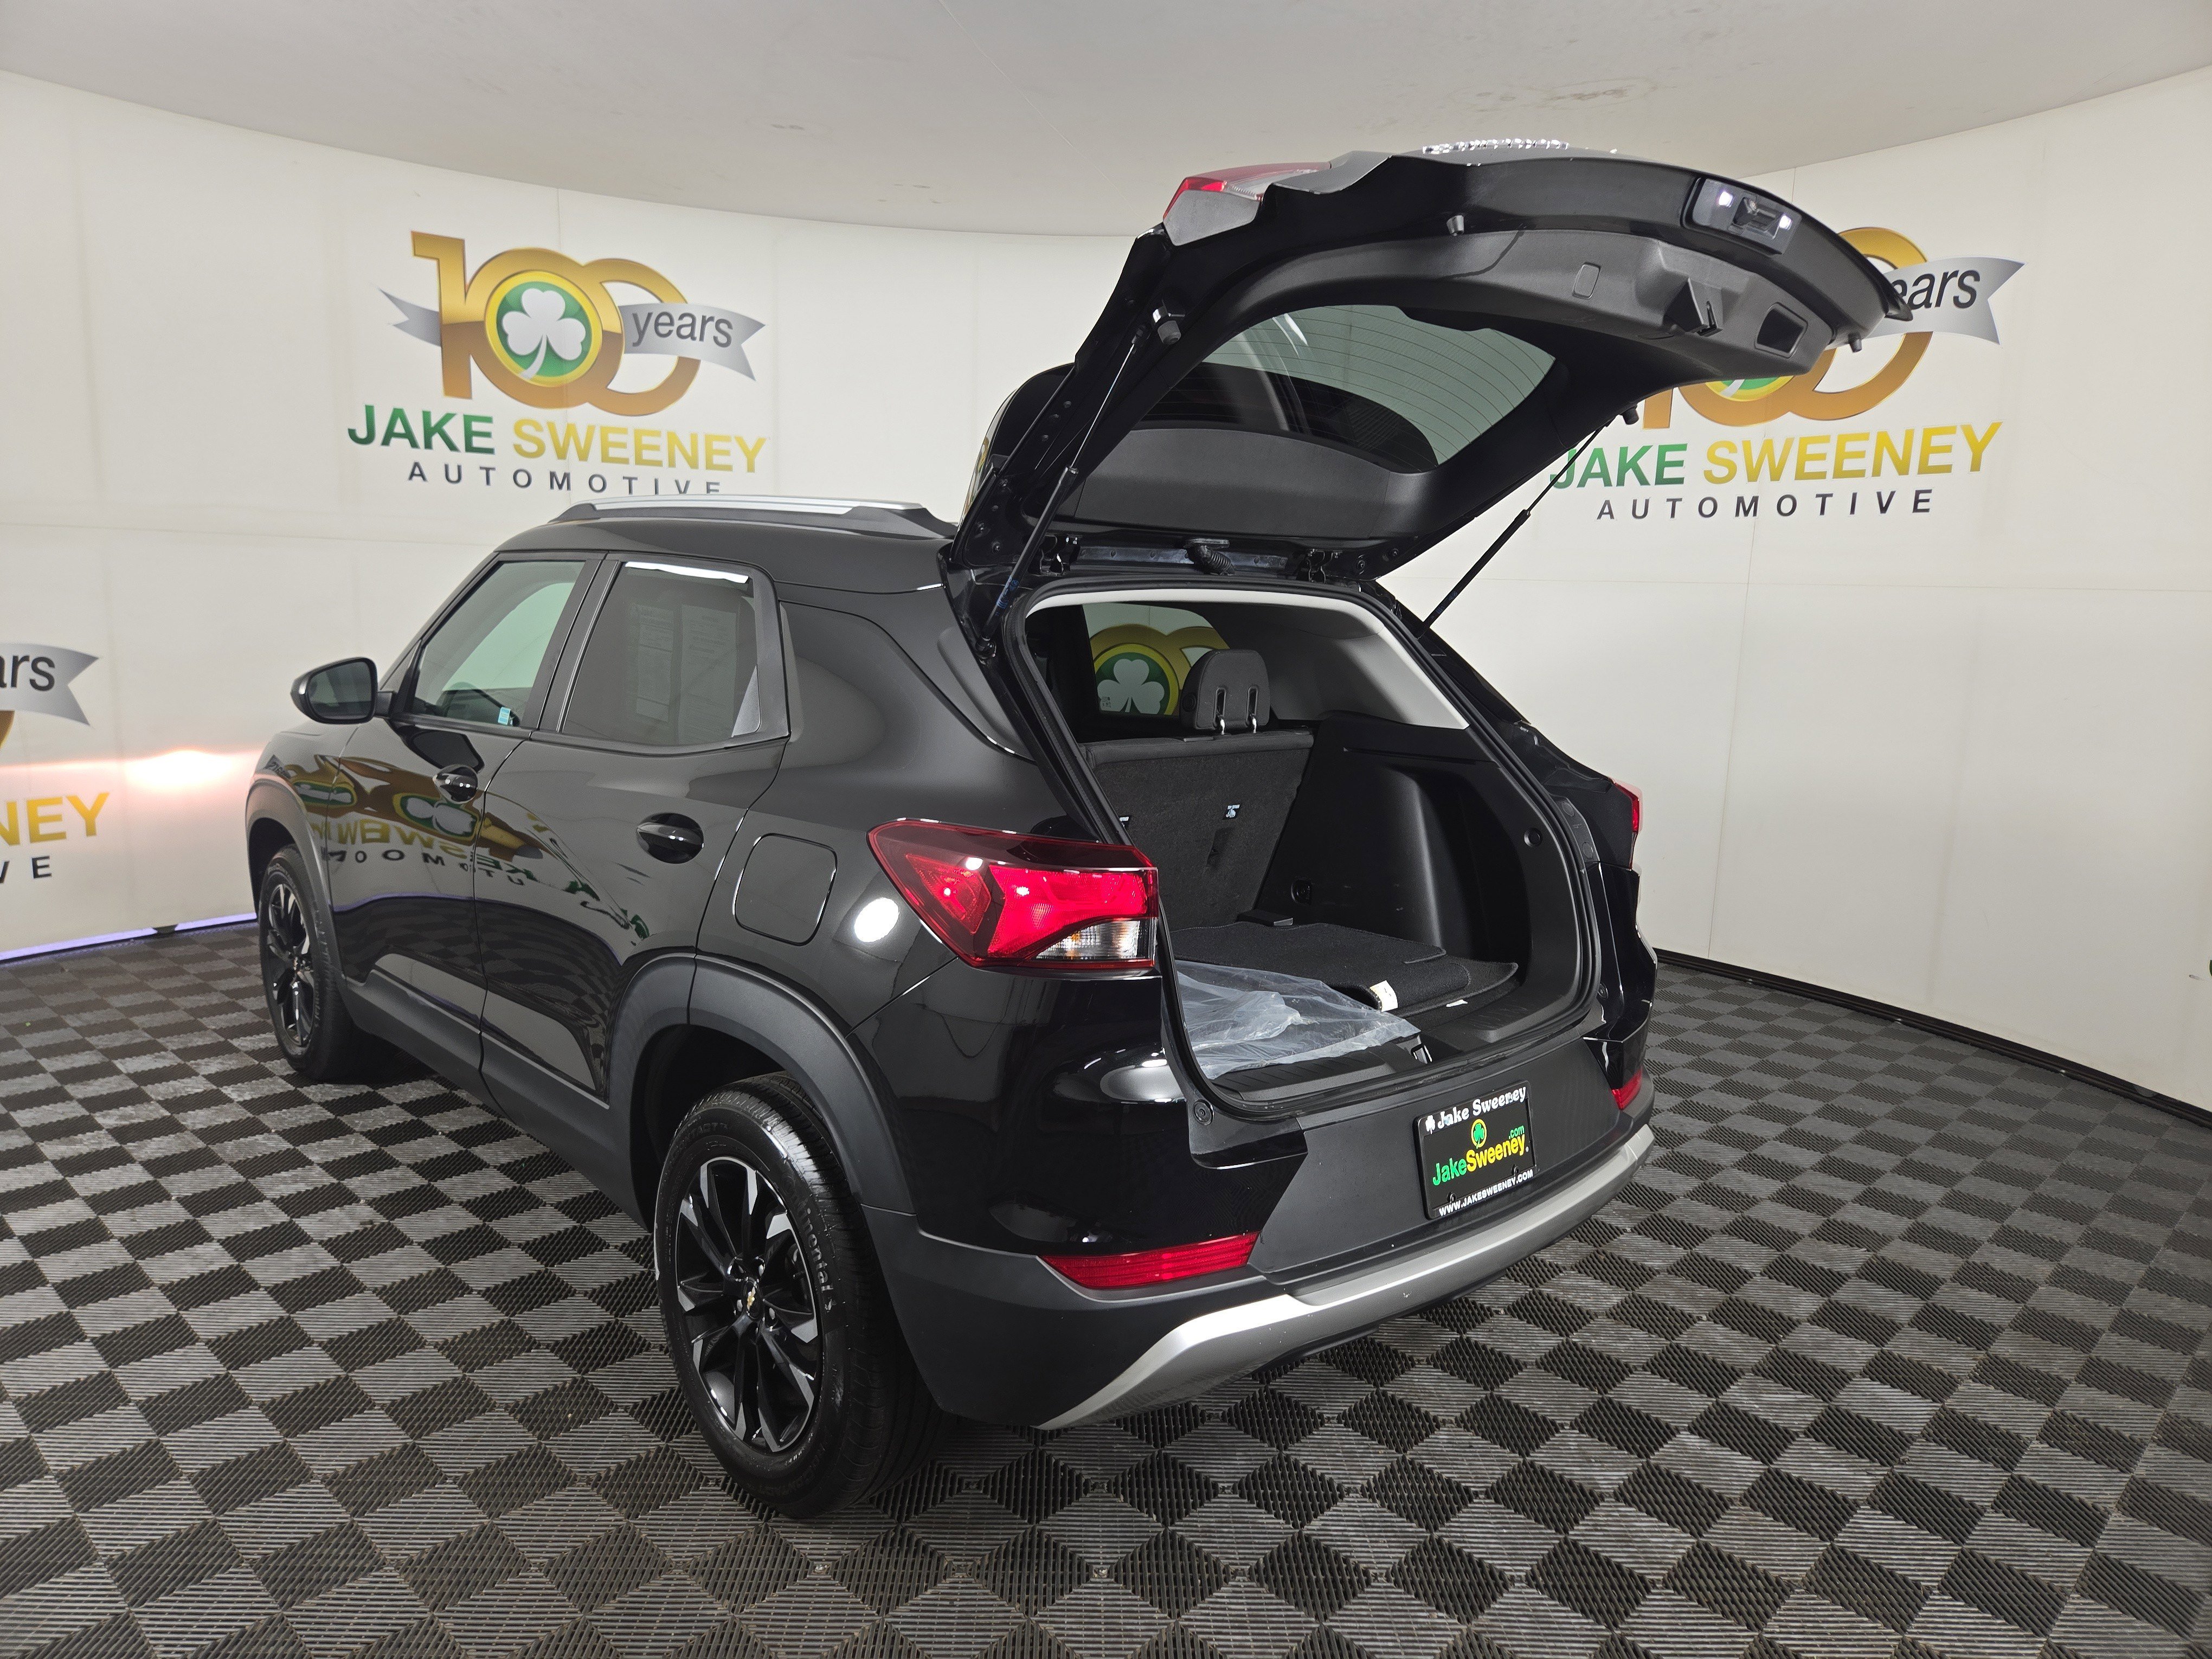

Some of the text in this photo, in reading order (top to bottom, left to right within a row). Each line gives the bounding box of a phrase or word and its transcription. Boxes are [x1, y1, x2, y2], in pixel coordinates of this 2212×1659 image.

[1892, 269, 1980, 310] ars
[632, 311, 733, 348] years
[348, 404, 767, 473] JAKE SWEENEY
[1550, 421, 2003, 488] JAKE SWEENEY
[408, 461, 720, 494] AUTOMOTIVE
[1597, 489, 1932, 520] AUTOMOTIVE
[1437, 1086, 1526, 1129] Jake Sweeney
[1438, 1169, 1533, 1216] WWW.JAKESWEENEY.COM
